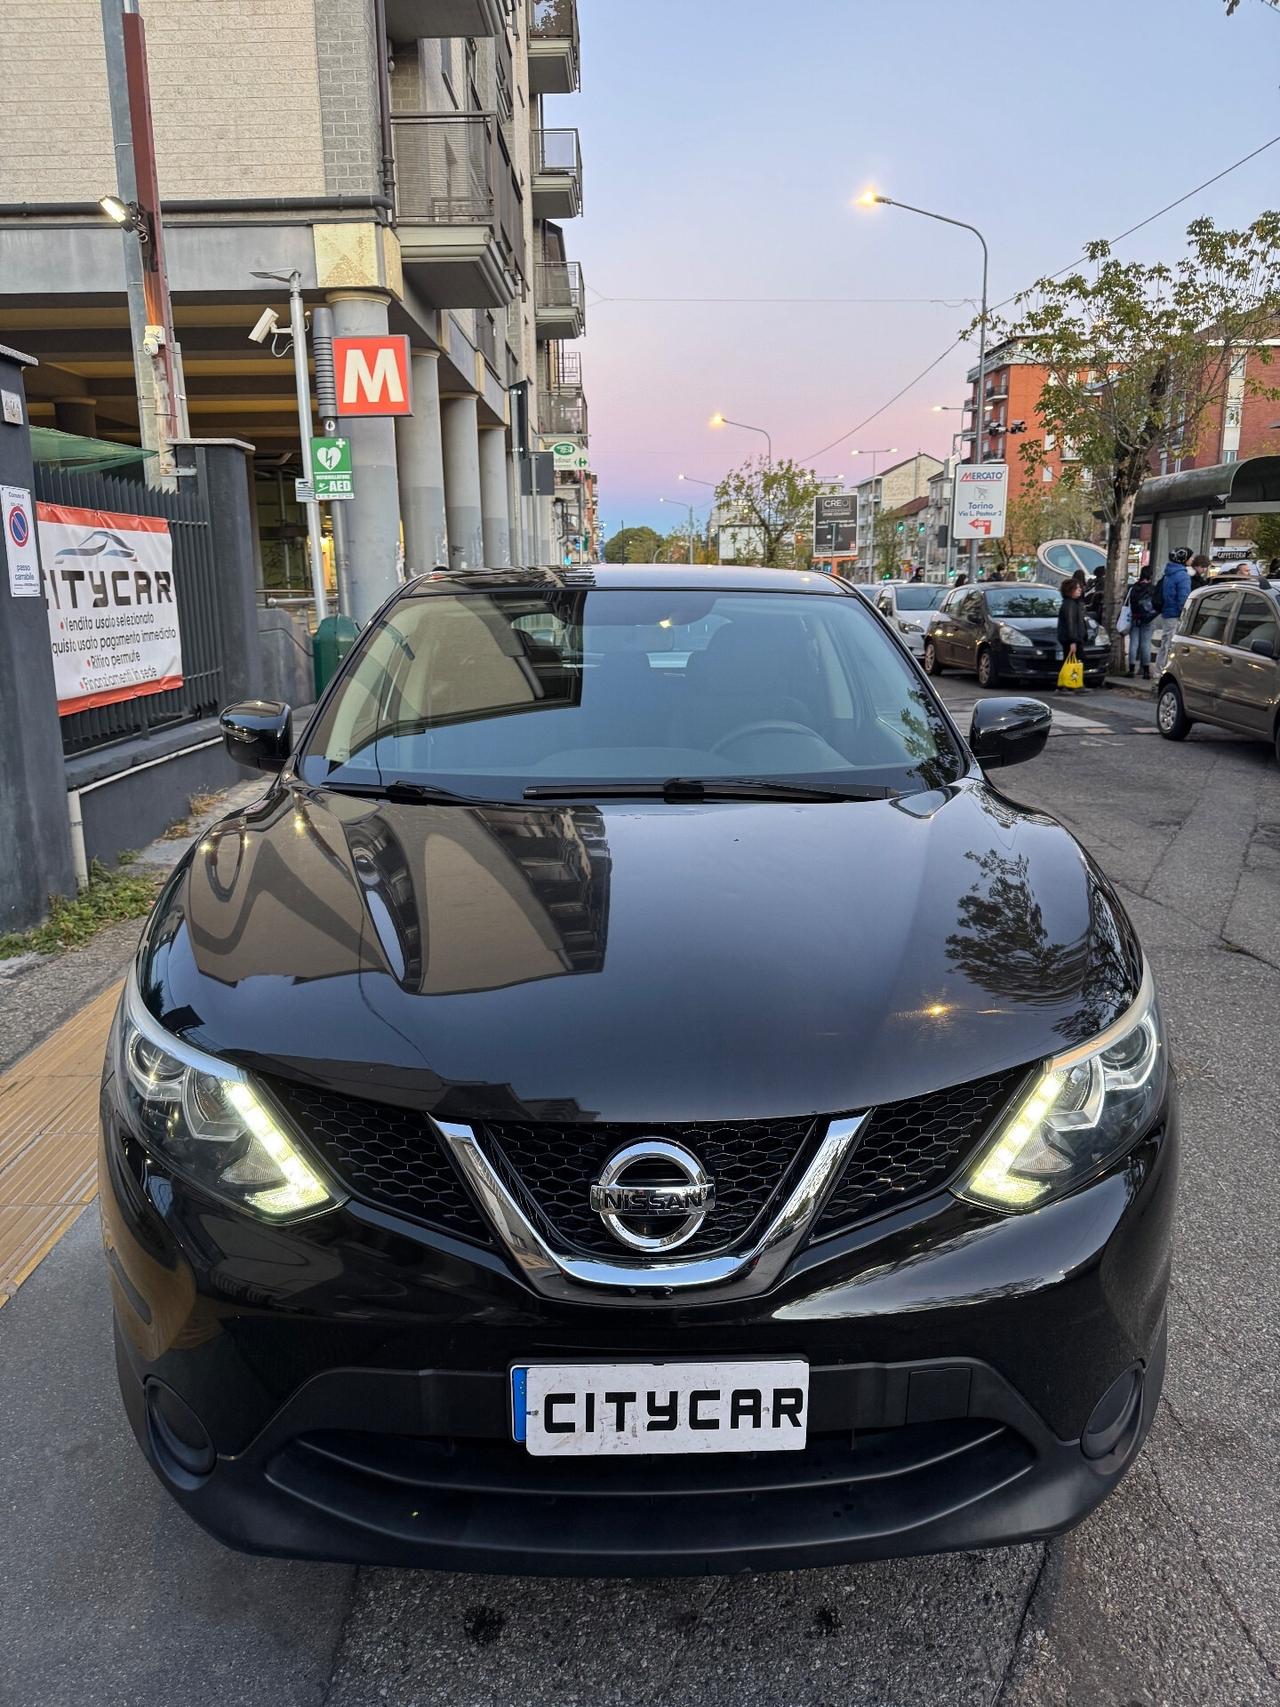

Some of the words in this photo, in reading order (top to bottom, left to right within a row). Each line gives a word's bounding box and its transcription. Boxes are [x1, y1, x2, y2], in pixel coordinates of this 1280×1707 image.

[343, 349, 405, 403] M
[329, 480, 351, 492] AED
[968, 501, 994, 510] Torino
[15, 572, 35, 581] carrabile
[43, 569, 173, 609] ITYCAR
[64, 616, 93, 632] Vendita
[95, 614, 115, 629] usato
[116, 611, 154, 627] selezionato
[52, 638, 76, 656] quisto
[77, 635, 98, 652] usato
[100, 631, 140, 651] pagamento
[141, 626, 176, 642] immediato
[91, 654, 110, 669] Ritiro
[111, 650, 140, 668] permute
[82, 667, 133, 691] Finanziamenti
[132, 668, 141, 681] in
[141, 664, 157, 679] sede
[603, 1192, 704, 1210] NISSAN
[544, 1388, 804, 1433] CITYCAR
